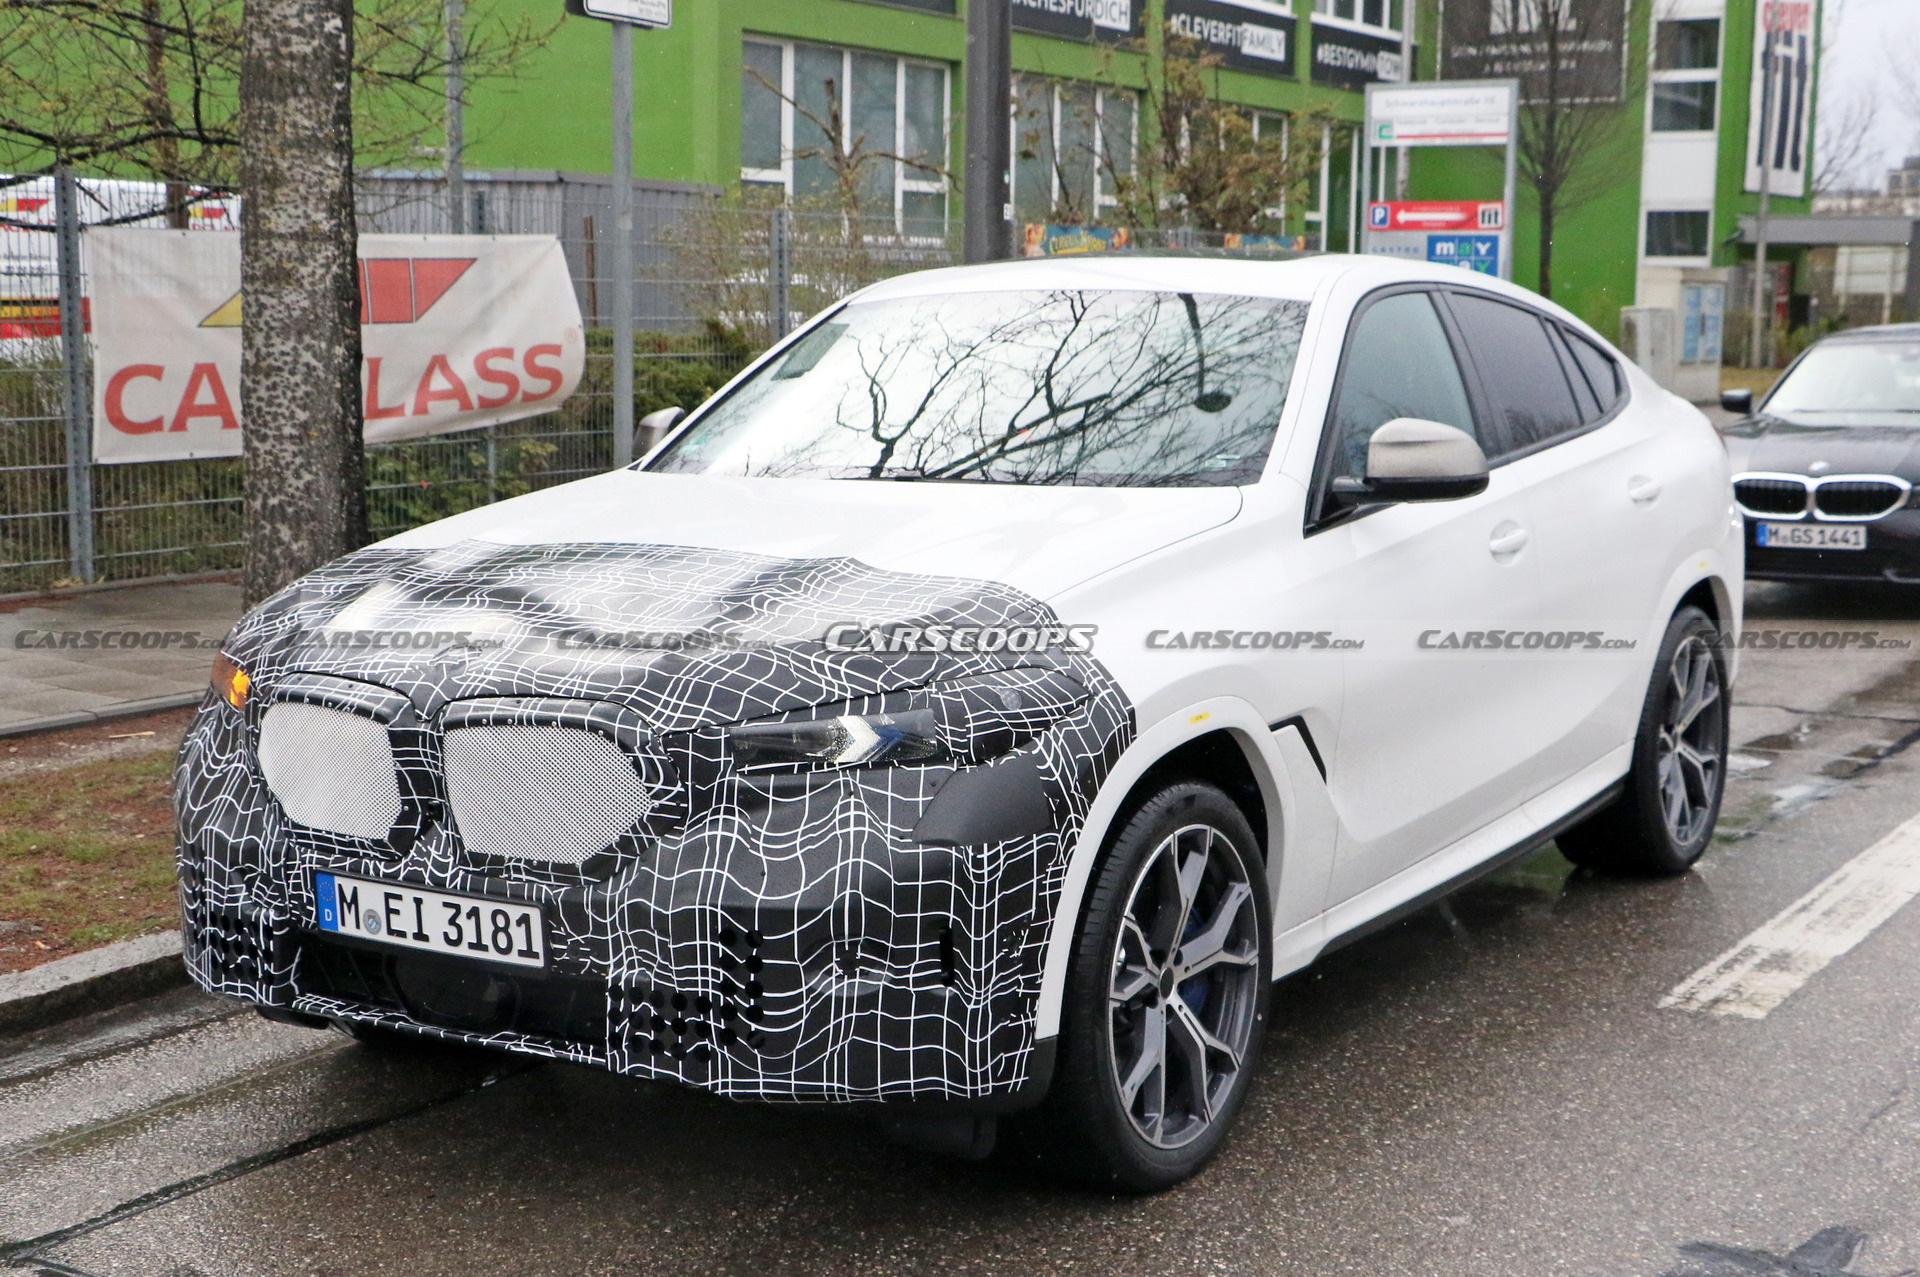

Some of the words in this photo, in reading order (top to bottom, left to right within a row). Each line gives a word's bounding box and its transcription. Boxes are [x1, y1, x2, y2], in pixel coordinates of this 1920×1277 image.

[1171, 13, 1284, 56] #CLEVERFITFAMILY
[1374, 207, 1385, 224] P
[104, 343, 563, 435] CALASS
[1768, 528, 1780, 543] M
[1790, 528, 1814, 545] GS
[1818, 529, 1862, 546] 1441
[324, 908, 332, 922] D
[337, 882, 361, 930] M
[384, 891, 430, 943] EI
[442, 900, 541, 961] 3181
